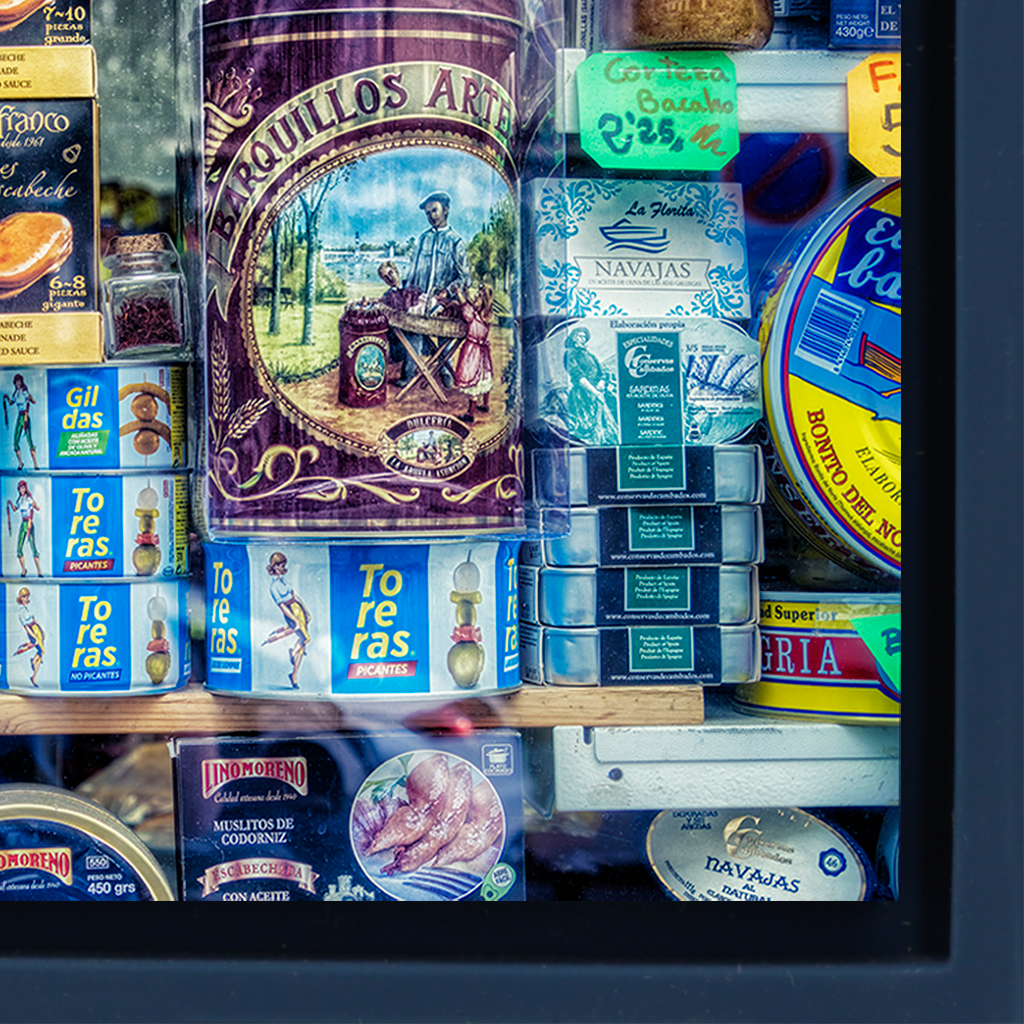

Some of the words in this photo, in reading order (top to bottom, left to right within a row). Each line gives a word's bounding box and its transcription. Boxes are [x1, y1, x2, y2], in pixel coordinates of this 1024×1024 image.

[625, 201, 647, 217] La
[650, 202, 698, 218] Florita
[594, 260, 691, 281] NAVAJAS
[609, 320, 657, 329] Elaboración
[659, 321, 685, 329] propia
[66, 385, 100, 408] Gil
[62, 409, 104, 429] das
[806, 408, 848, 487] BONITO
[841, 484, 877, 526] DEL
[71, 488, 105, 513] To
[69, 514, 100, 535] re
[68, 560, 108, 571] PICANTES
[359, 563, 403, 597] To
[78, 595, 112, 622] To
[356, 600, 397, 629] re
[775, 605, 838, 623] Superior
[77, 623, 108, 644] re
[70, 671, 83, 681] NO
[84, 670, 120, 680] PICANTES
[356, 664, 408, 676] PICANTES
[213, 819, 275, 831] MUSLITOS
[276, 818, 295, 830] DE
[221, 832, 288, 845] CODORNIZ
[211, 862, 303, 880] ESCABECHADA
[704, 855, 801, 894] NAVAJAS
[87, 883, 112, 894] 450
[114, 883, 136, 896] grs
